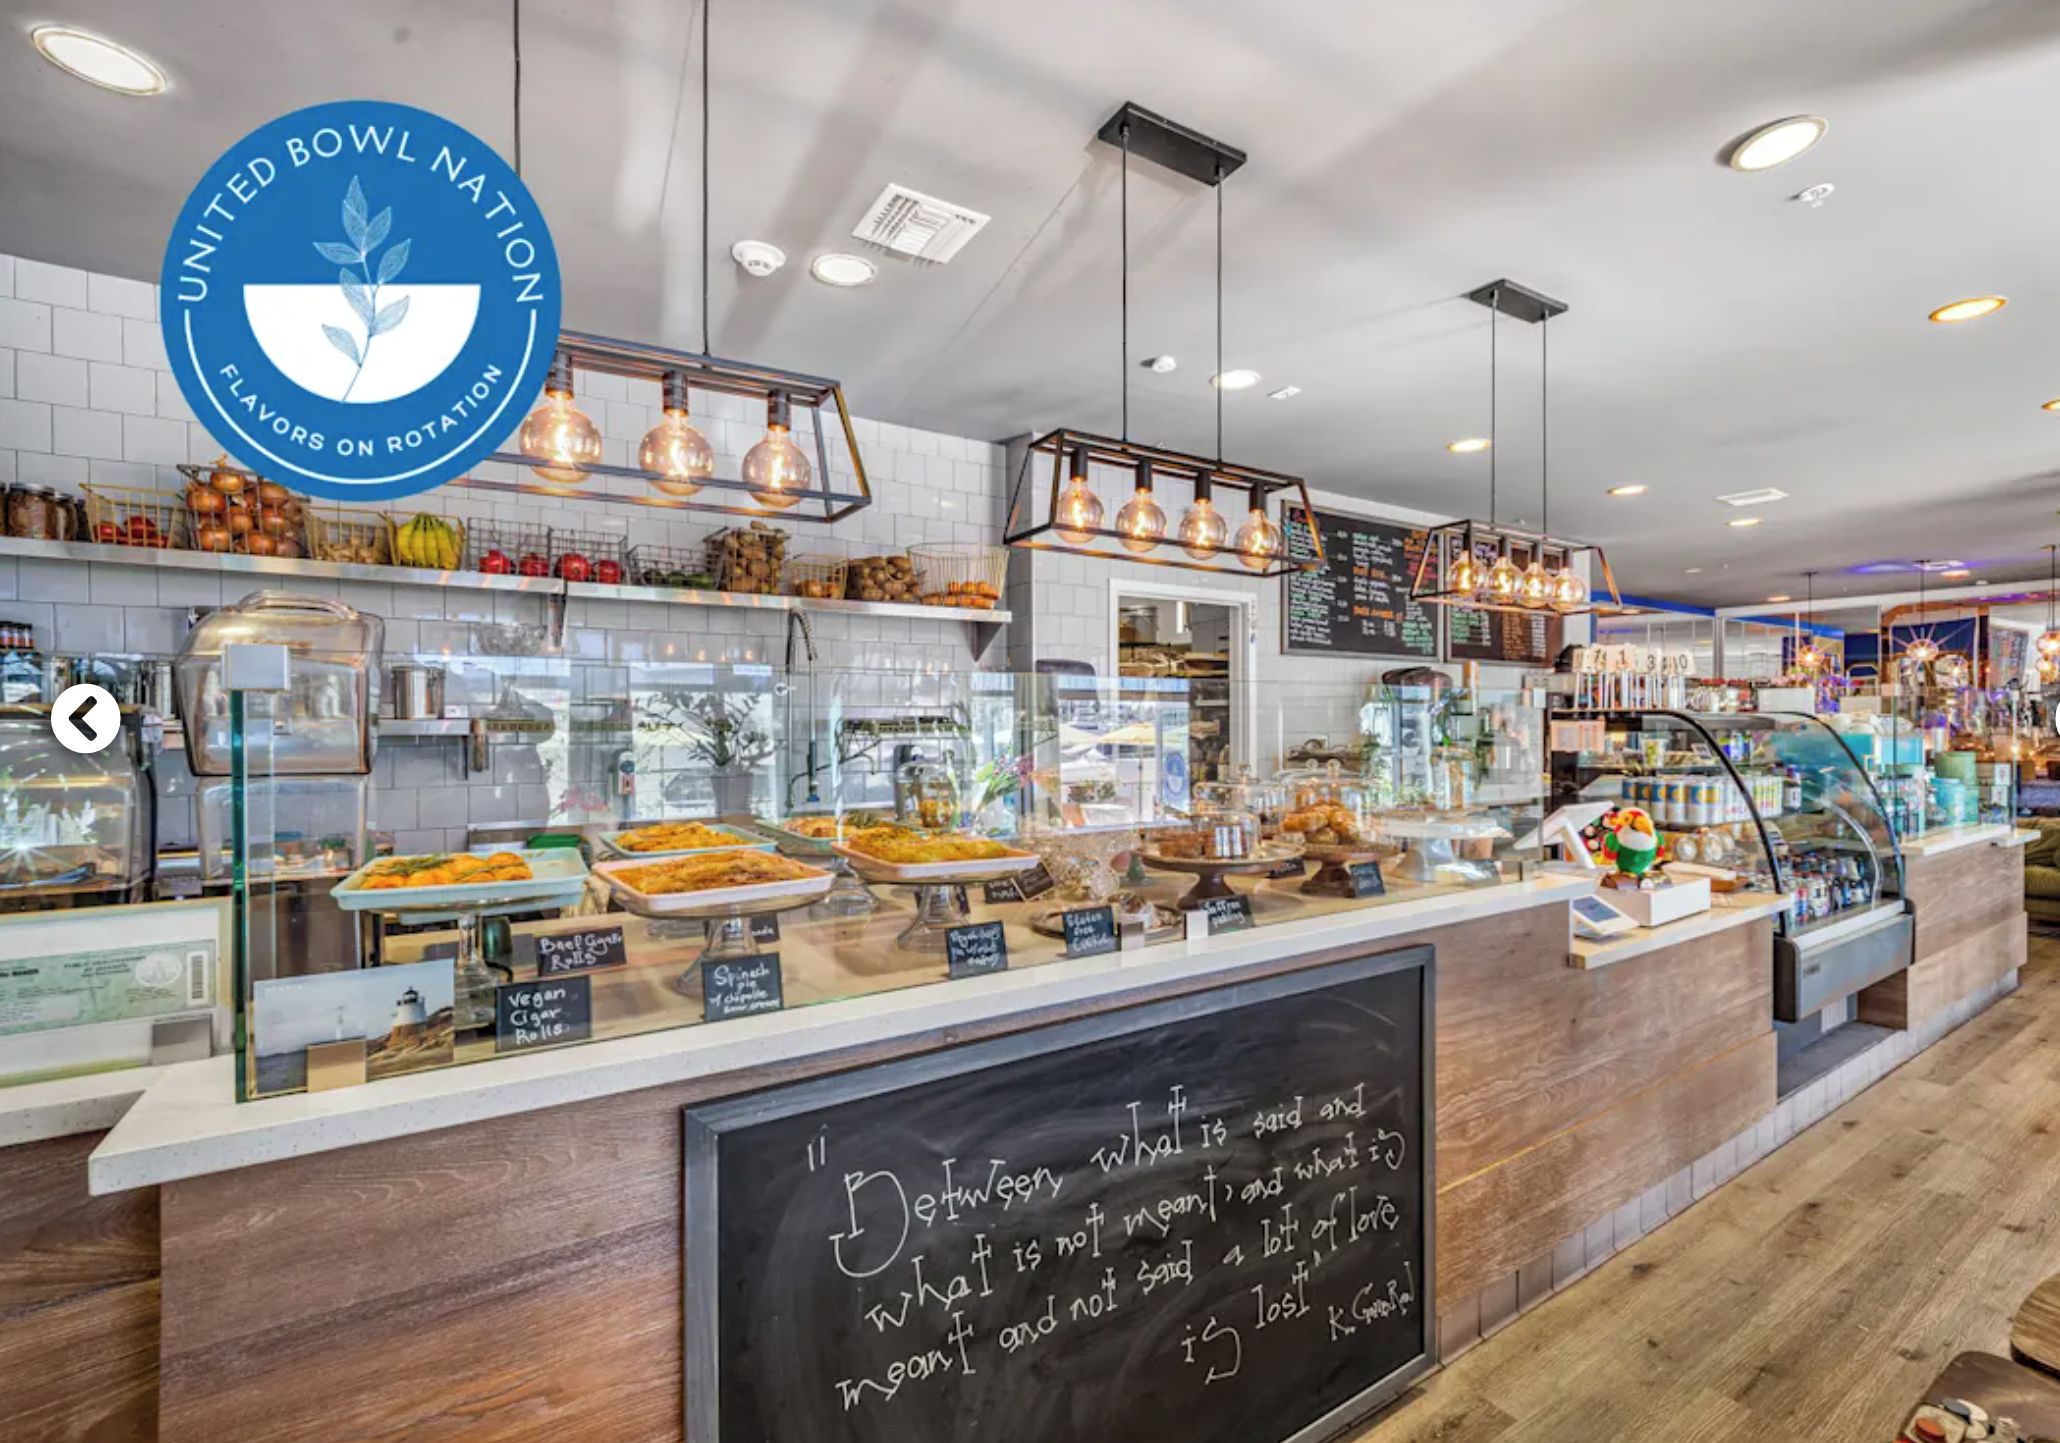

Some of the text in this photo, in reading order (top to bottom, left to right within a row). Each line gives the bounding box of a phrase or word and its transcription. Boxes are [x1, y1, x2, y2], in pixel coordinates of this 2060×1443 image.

[713, 962, 770, 987] Spinach
[510, 1007, 562, 1027] Cigar
[515, 1022, 563, 1046] Rolls
[1090, 1085, 1186, 1173] what
[1201, 1115, 1227, 1148] is
[1253, 1095, 1304, 1138] said
[1319, 1082, 1367, 1120] and
[864, 1233, 993, 1333] what
[1012, 1241, 1043, 1272] is
[1056, 1202, 1105, 1258] not
[1240, 1166, 1284, 1204] and
[1293, 1131, 1360, 1182] what
[1367, 1127, 1406, 1171] is
[834, 1185, 1400, 1412] meant and not said a lot of love
[1181, 1316, 1242, 1386] is
